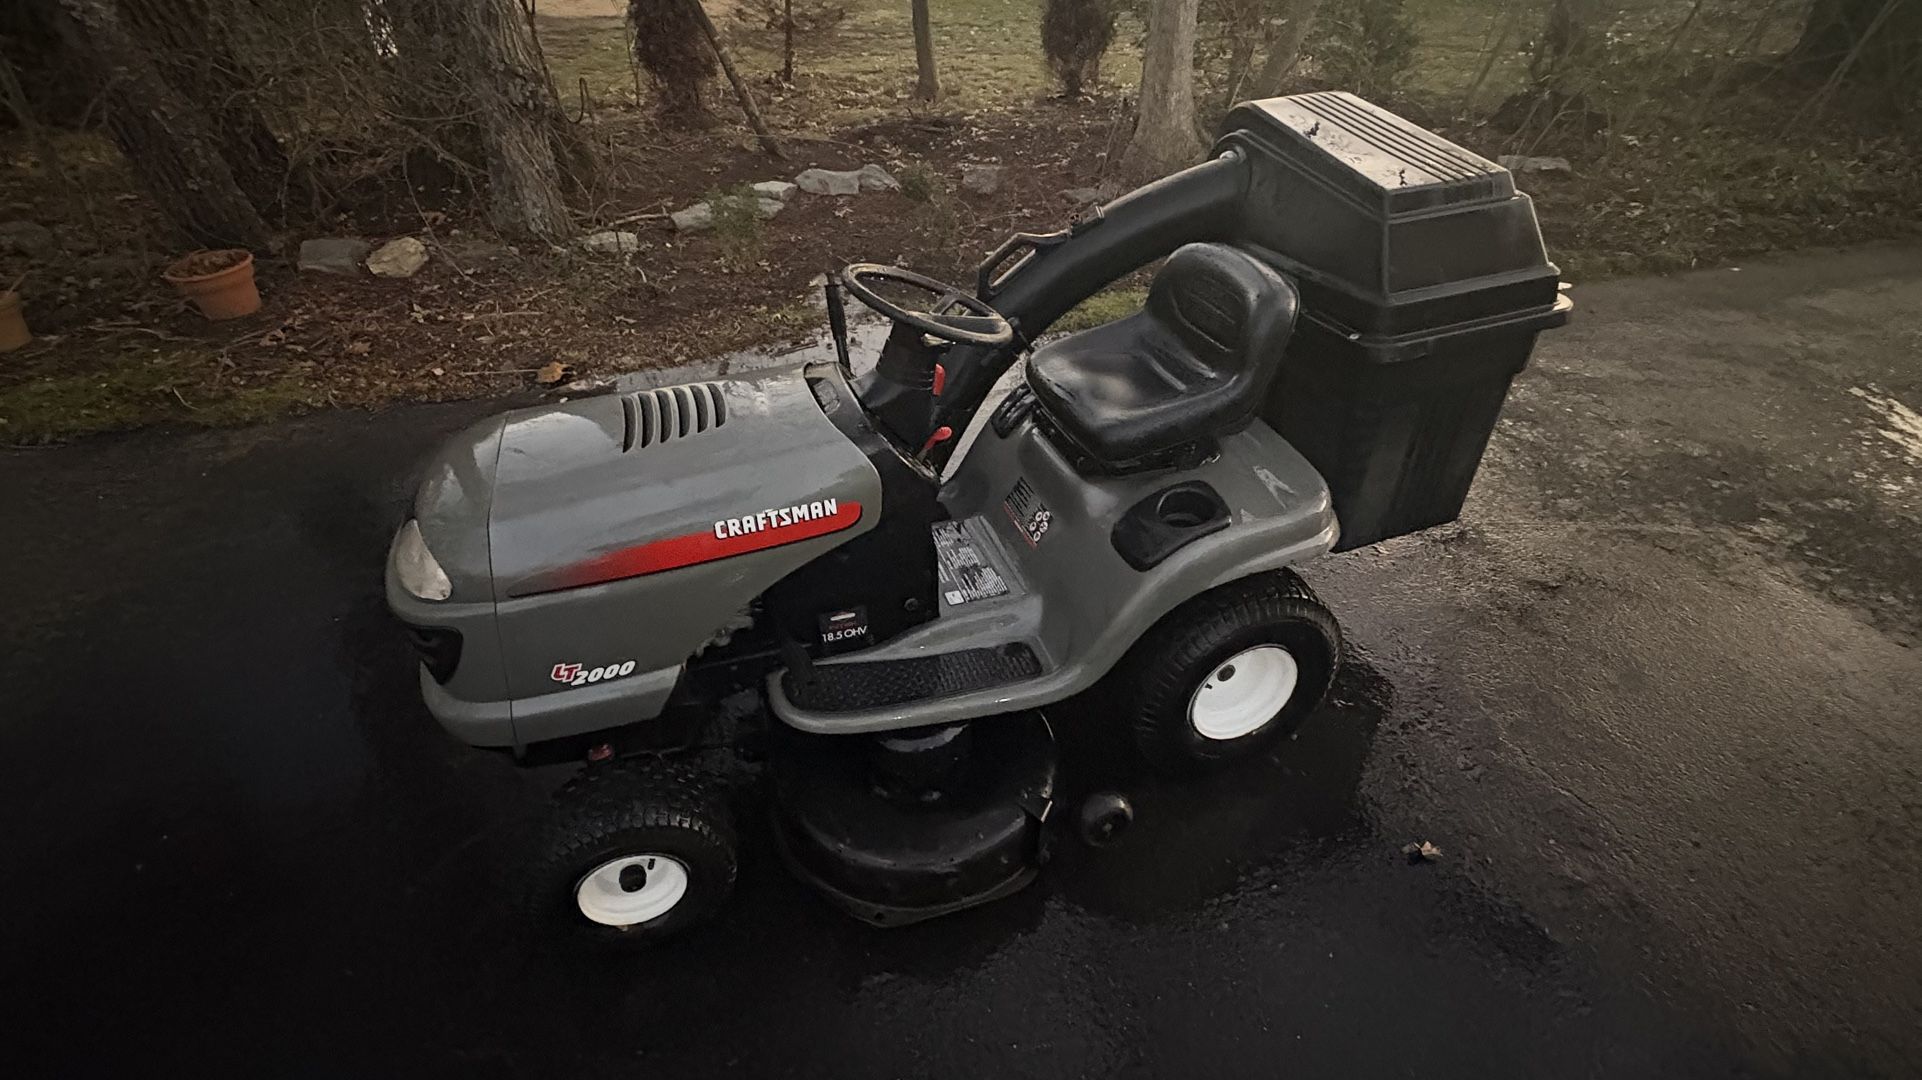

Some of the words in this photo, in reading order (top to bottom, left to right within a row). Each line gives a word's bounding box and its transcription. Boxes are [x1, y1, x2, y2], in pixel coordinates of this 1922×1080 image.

[714, 498, 838, 539] CRAFTSMAN
[822, 630, 843, 643] 18.5
[843, 625, 868, 638] OHV
